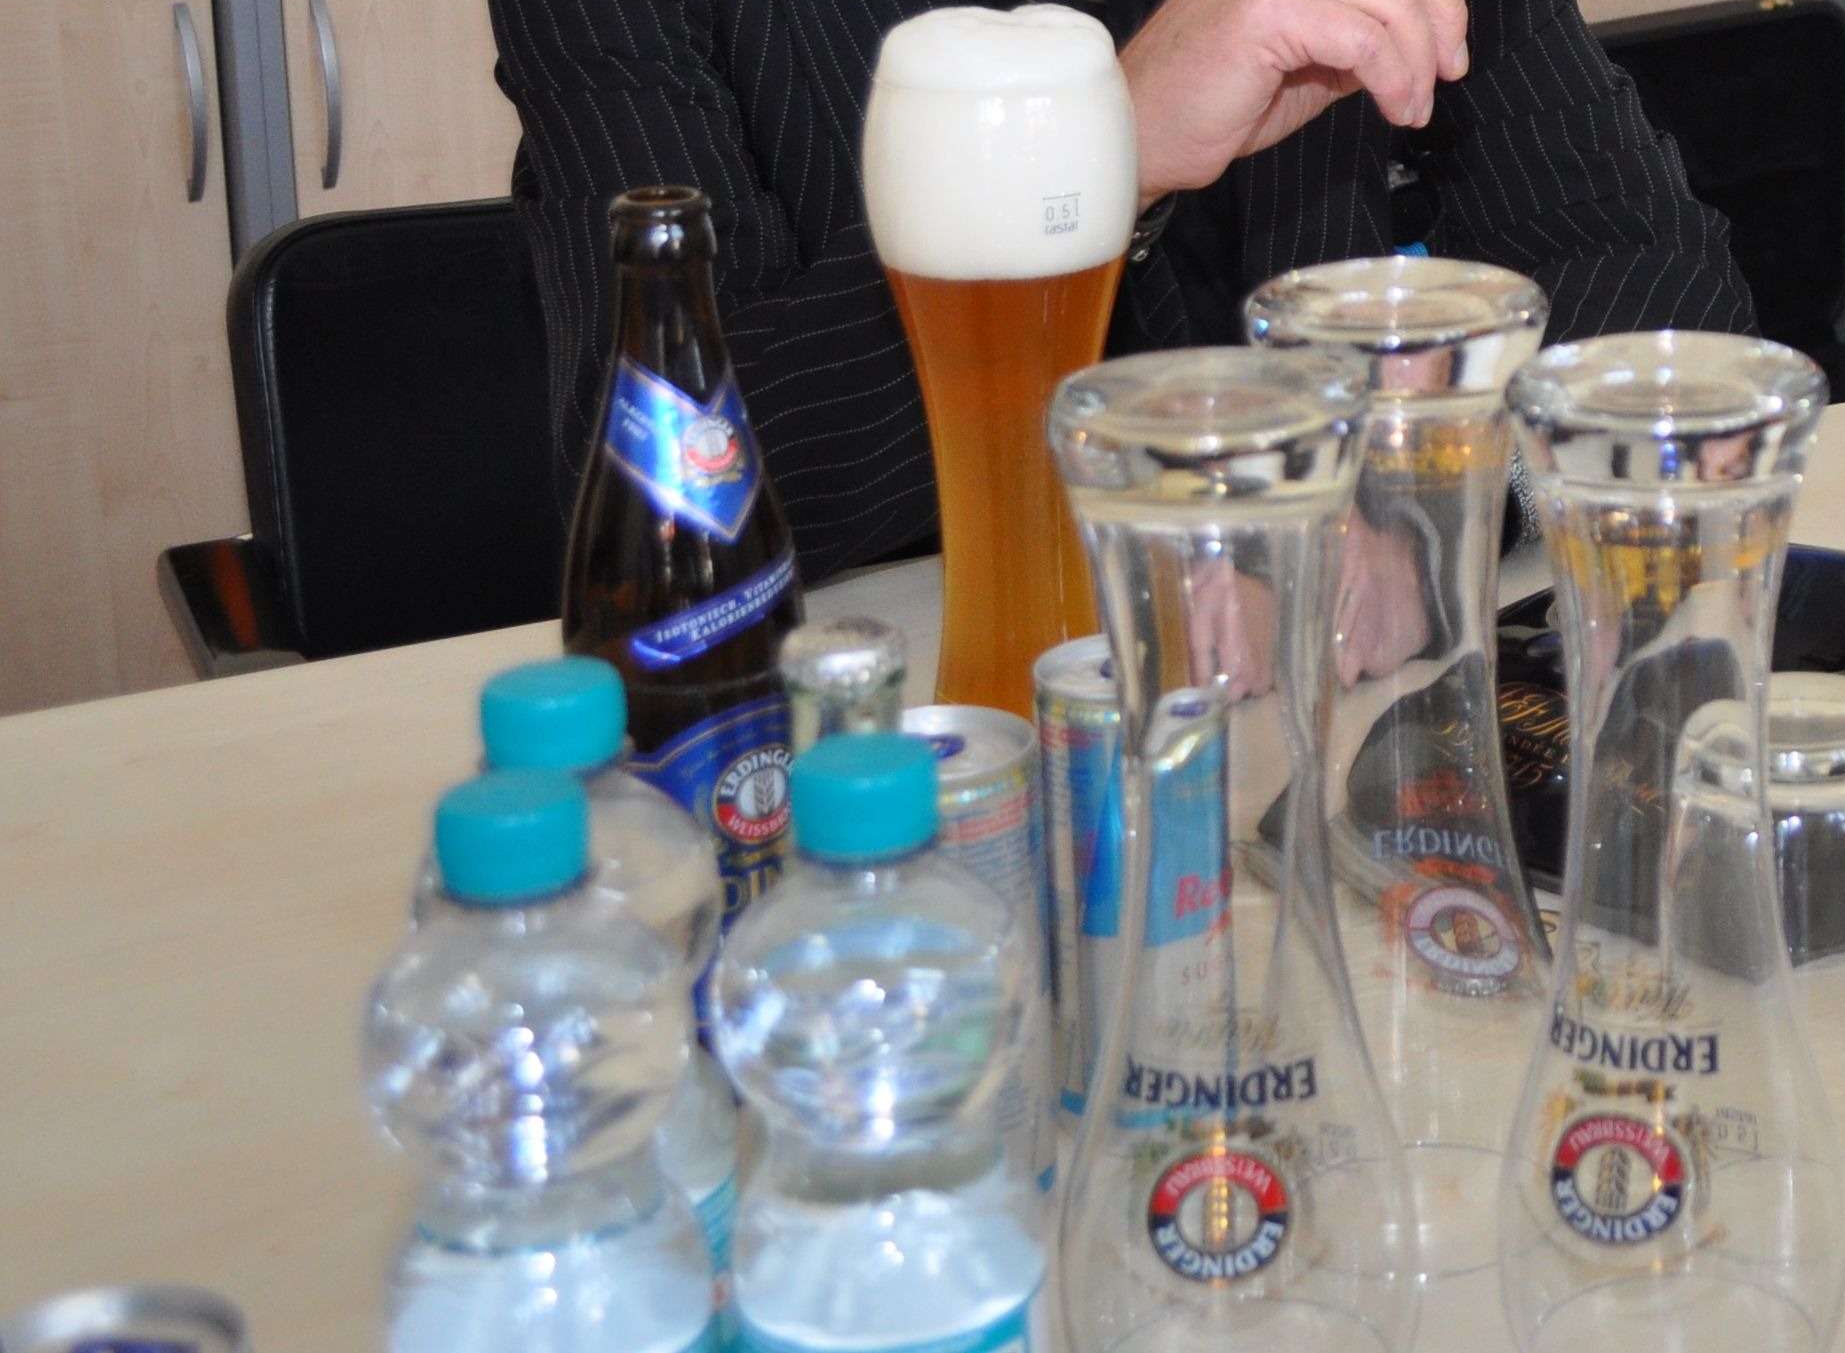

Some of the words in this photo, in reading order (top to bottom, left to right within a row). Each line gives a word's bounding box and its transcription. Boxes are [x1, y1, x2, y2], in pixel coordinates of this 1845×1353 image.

[719, 747, 794, 798] ERDINGE
[727, 806, 791, 838] WEISSBR
[1550, 1013, 1720, 1074] ERDINGER
[1123, 1052, 1317, 1109] ERDINGER
[1555, 1178, 1679, 1242] ERDINGER
[1155, 1219, 1285, 1278] ERDINGER
